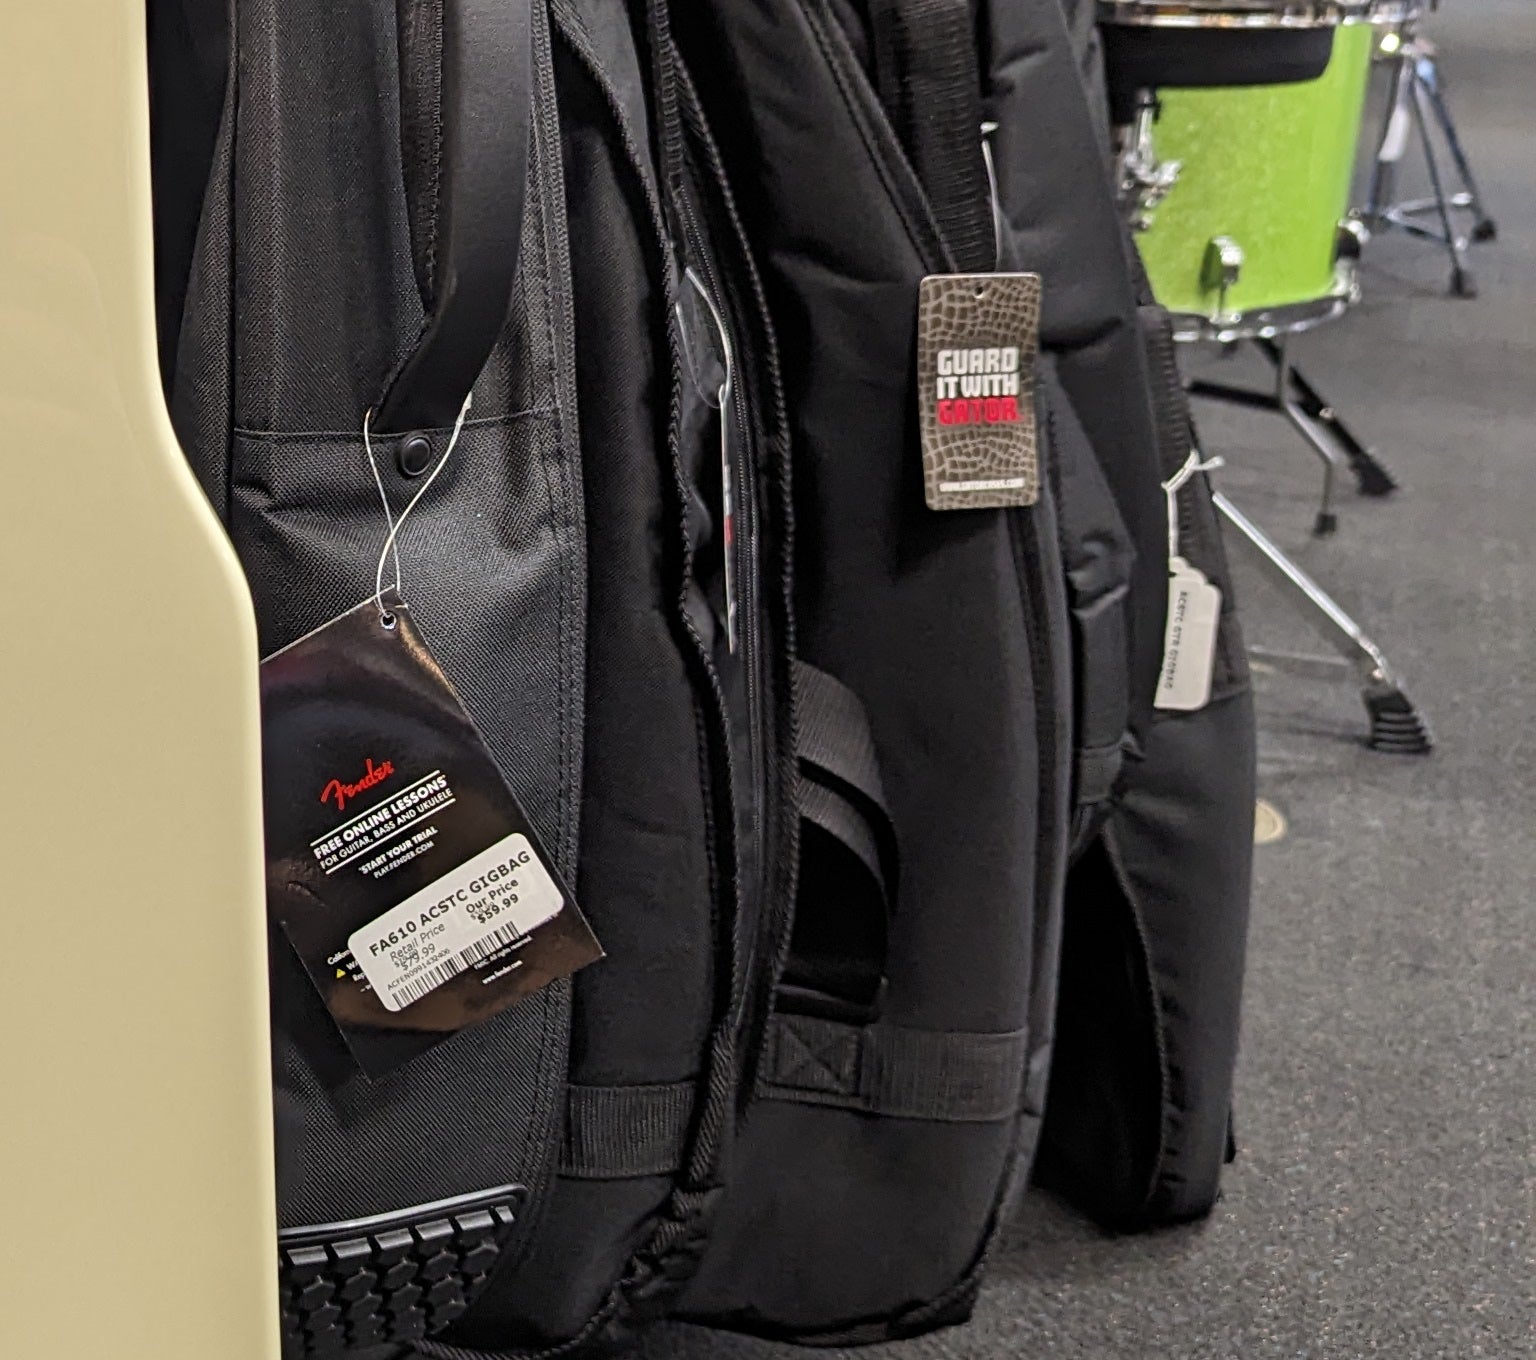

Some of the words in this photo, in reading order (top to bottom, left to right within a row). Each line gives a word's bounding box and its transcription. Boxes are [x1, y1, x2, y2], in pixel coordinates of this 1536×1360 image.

[937, 347, 1019, 375] GUARD
[936, 376, 958, 399] IT
[960, 373, 1020, 397] WITH
[321, 759, 394, 809] Fender
[313, 836, 343, 859] FREE
[343, 807, 392, 841] ONLINE
[320, 854, 339, 869] FOR
[339, 835, 373, 858] GUITAR,
[373, 821, 396, 838] BASS
[397, 809, 416, 825] AND
[416, 788, 453, 813] UKULELE
[386, 840, 413, 858] YOUR
[411, 826, 438, 844] TRIAL
[369, 921, 417, 957] FA610
[420, 889, 468, 926] ACSTC
[469, 851, 530, 893] GIGBAG
[466, 897, 486, 913] Our
[488, 879, 518, 900] Price
[474, 893, 518, 924] $59.99
[390, 938, 418, 961] Retail
[420, 924, 445, 943] Price
[398, 943, 435, 970] $79.99
